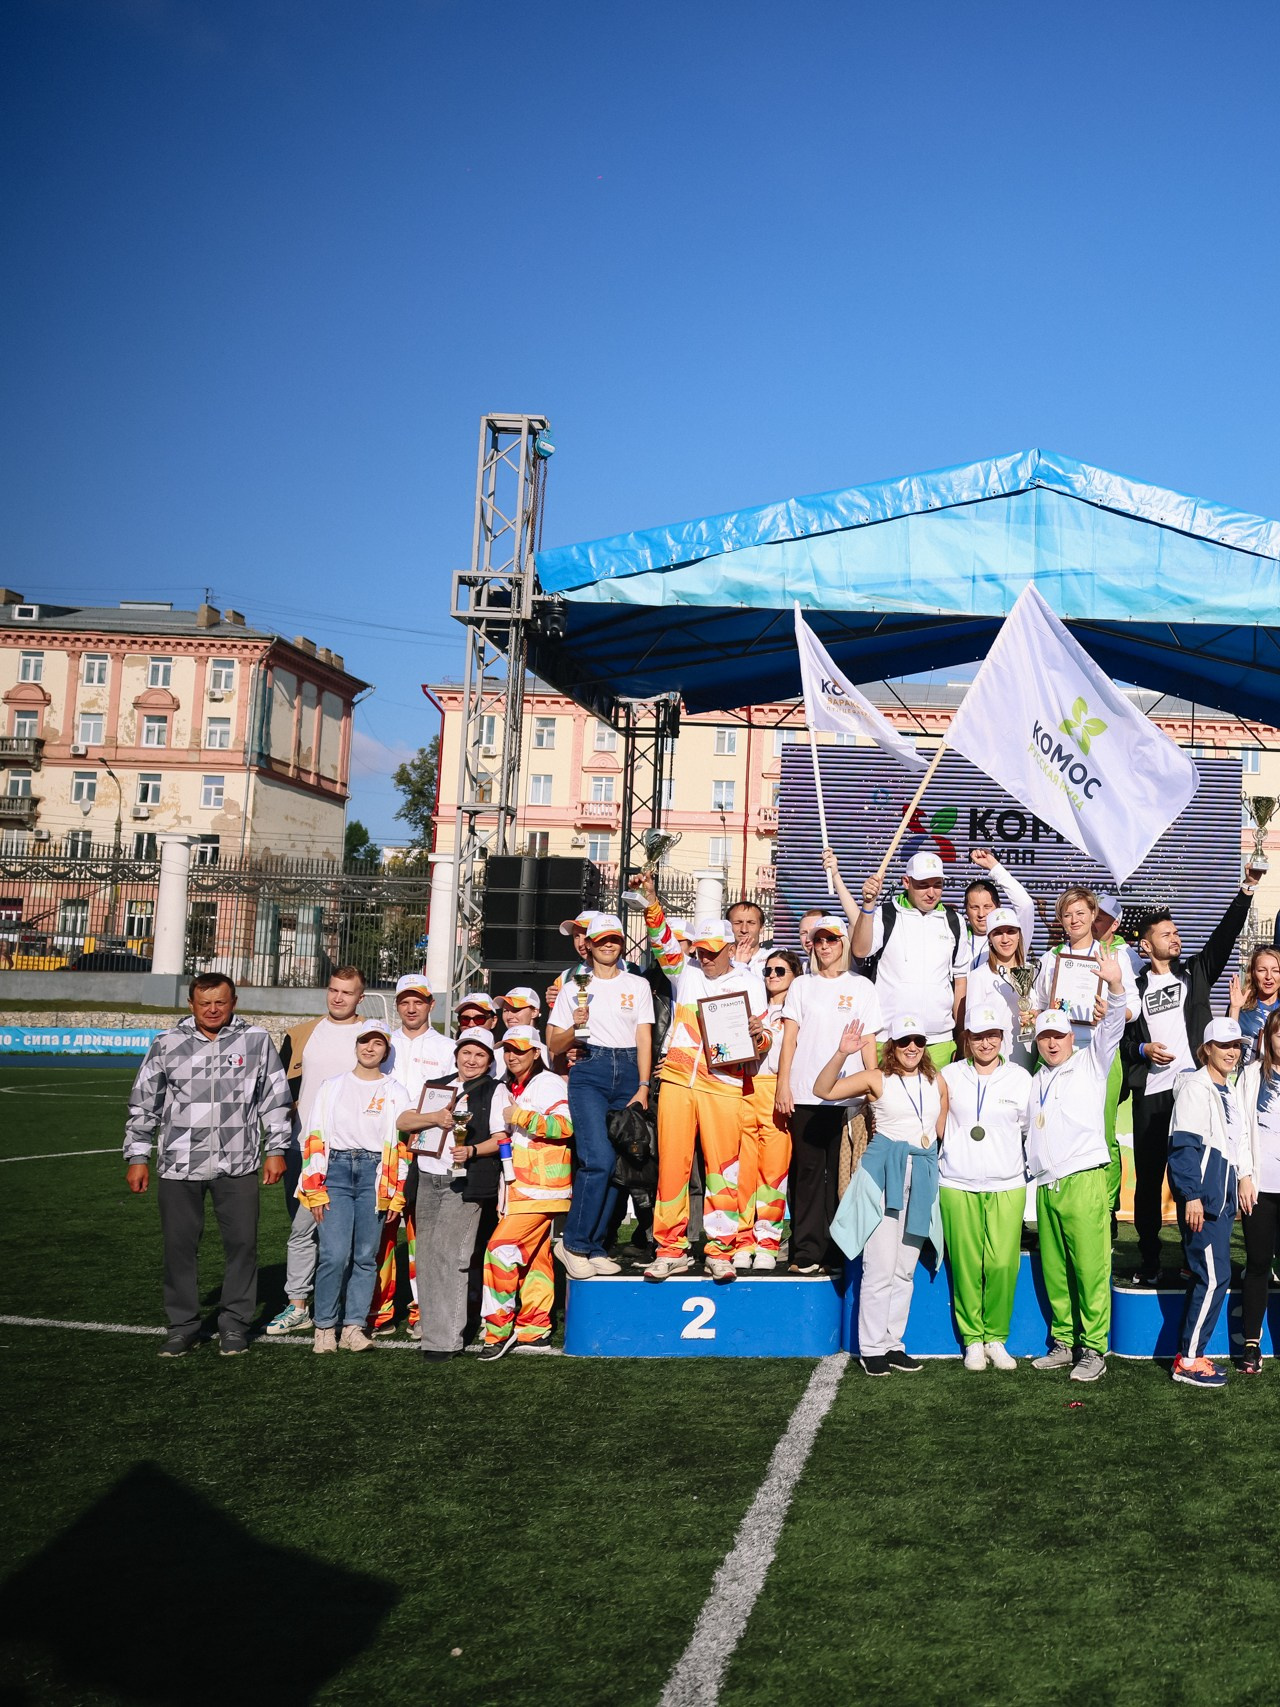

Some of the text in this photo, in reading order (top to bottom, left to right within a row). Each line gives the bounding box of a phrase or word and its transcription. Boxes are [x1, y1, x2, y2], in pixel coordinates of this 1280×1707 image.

[1033, 719, 1102, 800] КОМОС
[969, 808, 1065, 843] КОМ
[720, 1001, 745, 1009] ГРАМОТА
[23, 1034, 59, 1046] сила
[62, 1034, 71, 1046] в
[73, 1034, 150, 1047] движении
[680, 1296, 716, 1340] 2
